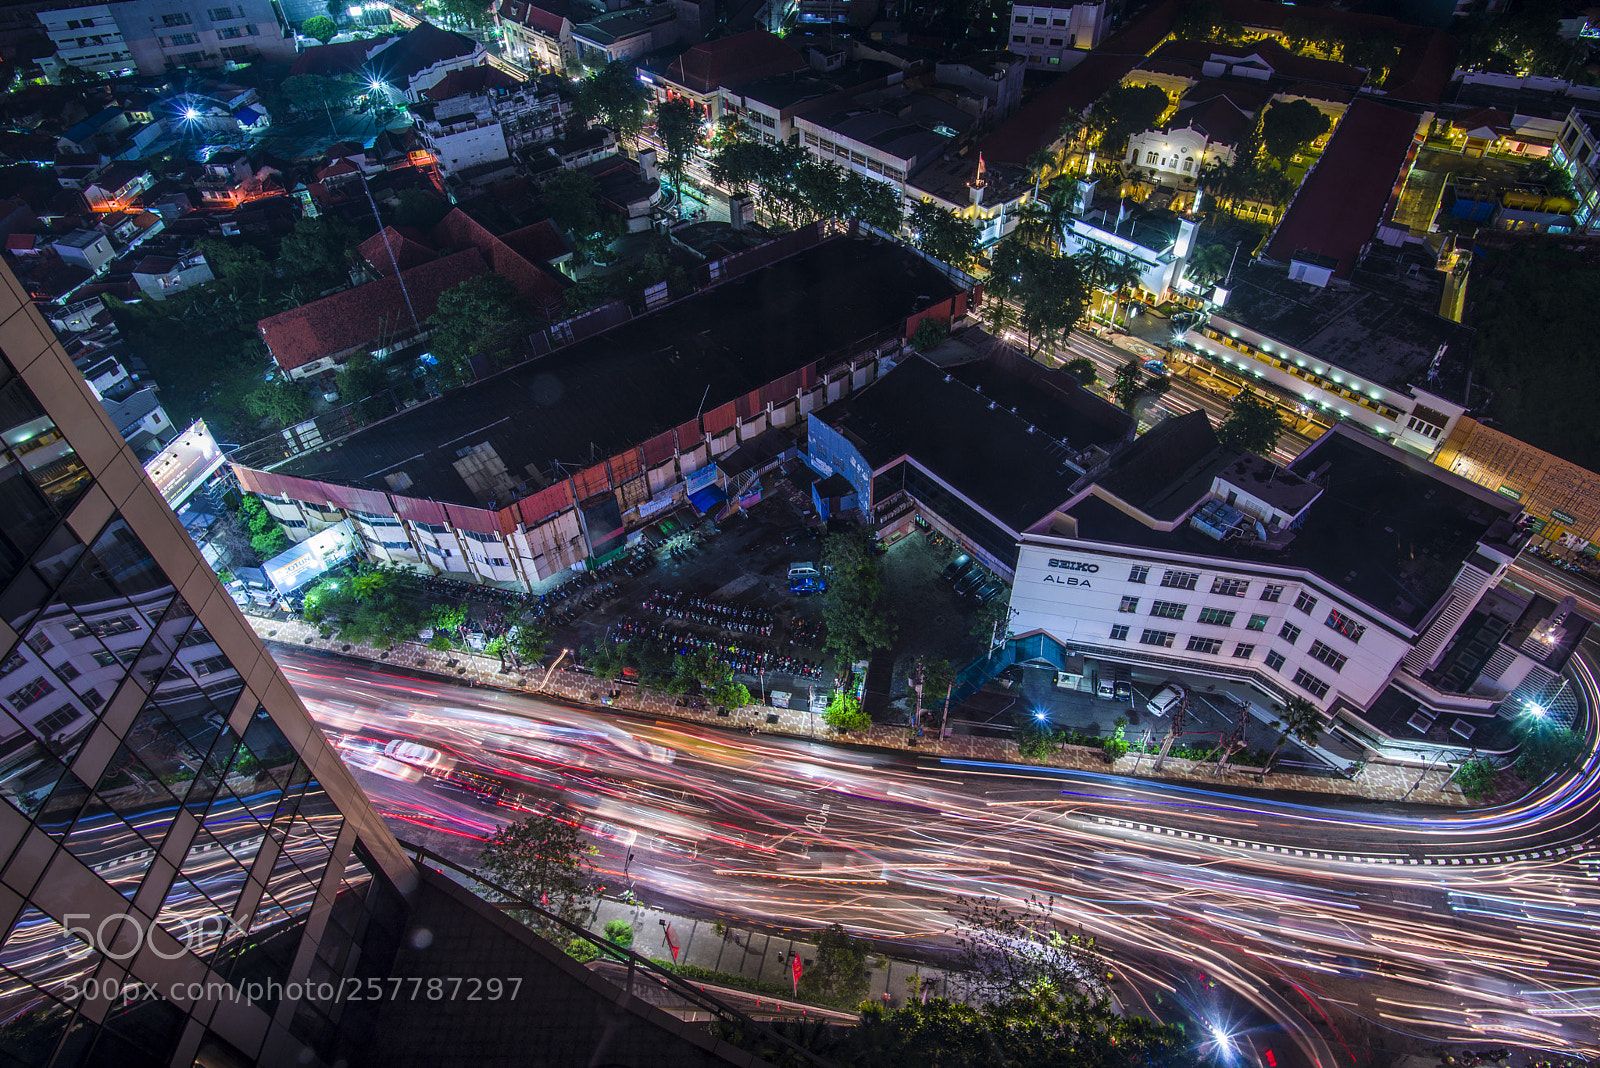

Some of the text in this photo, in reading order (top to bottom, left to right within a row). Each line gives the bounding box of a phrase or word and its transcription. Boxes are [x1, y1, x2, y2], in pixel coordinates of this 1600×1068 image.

[1048, 558, 1099, 573] SEIKO
[1043, 574, 1091, 588] ALBA
[804, 814, 827, 833] 40
